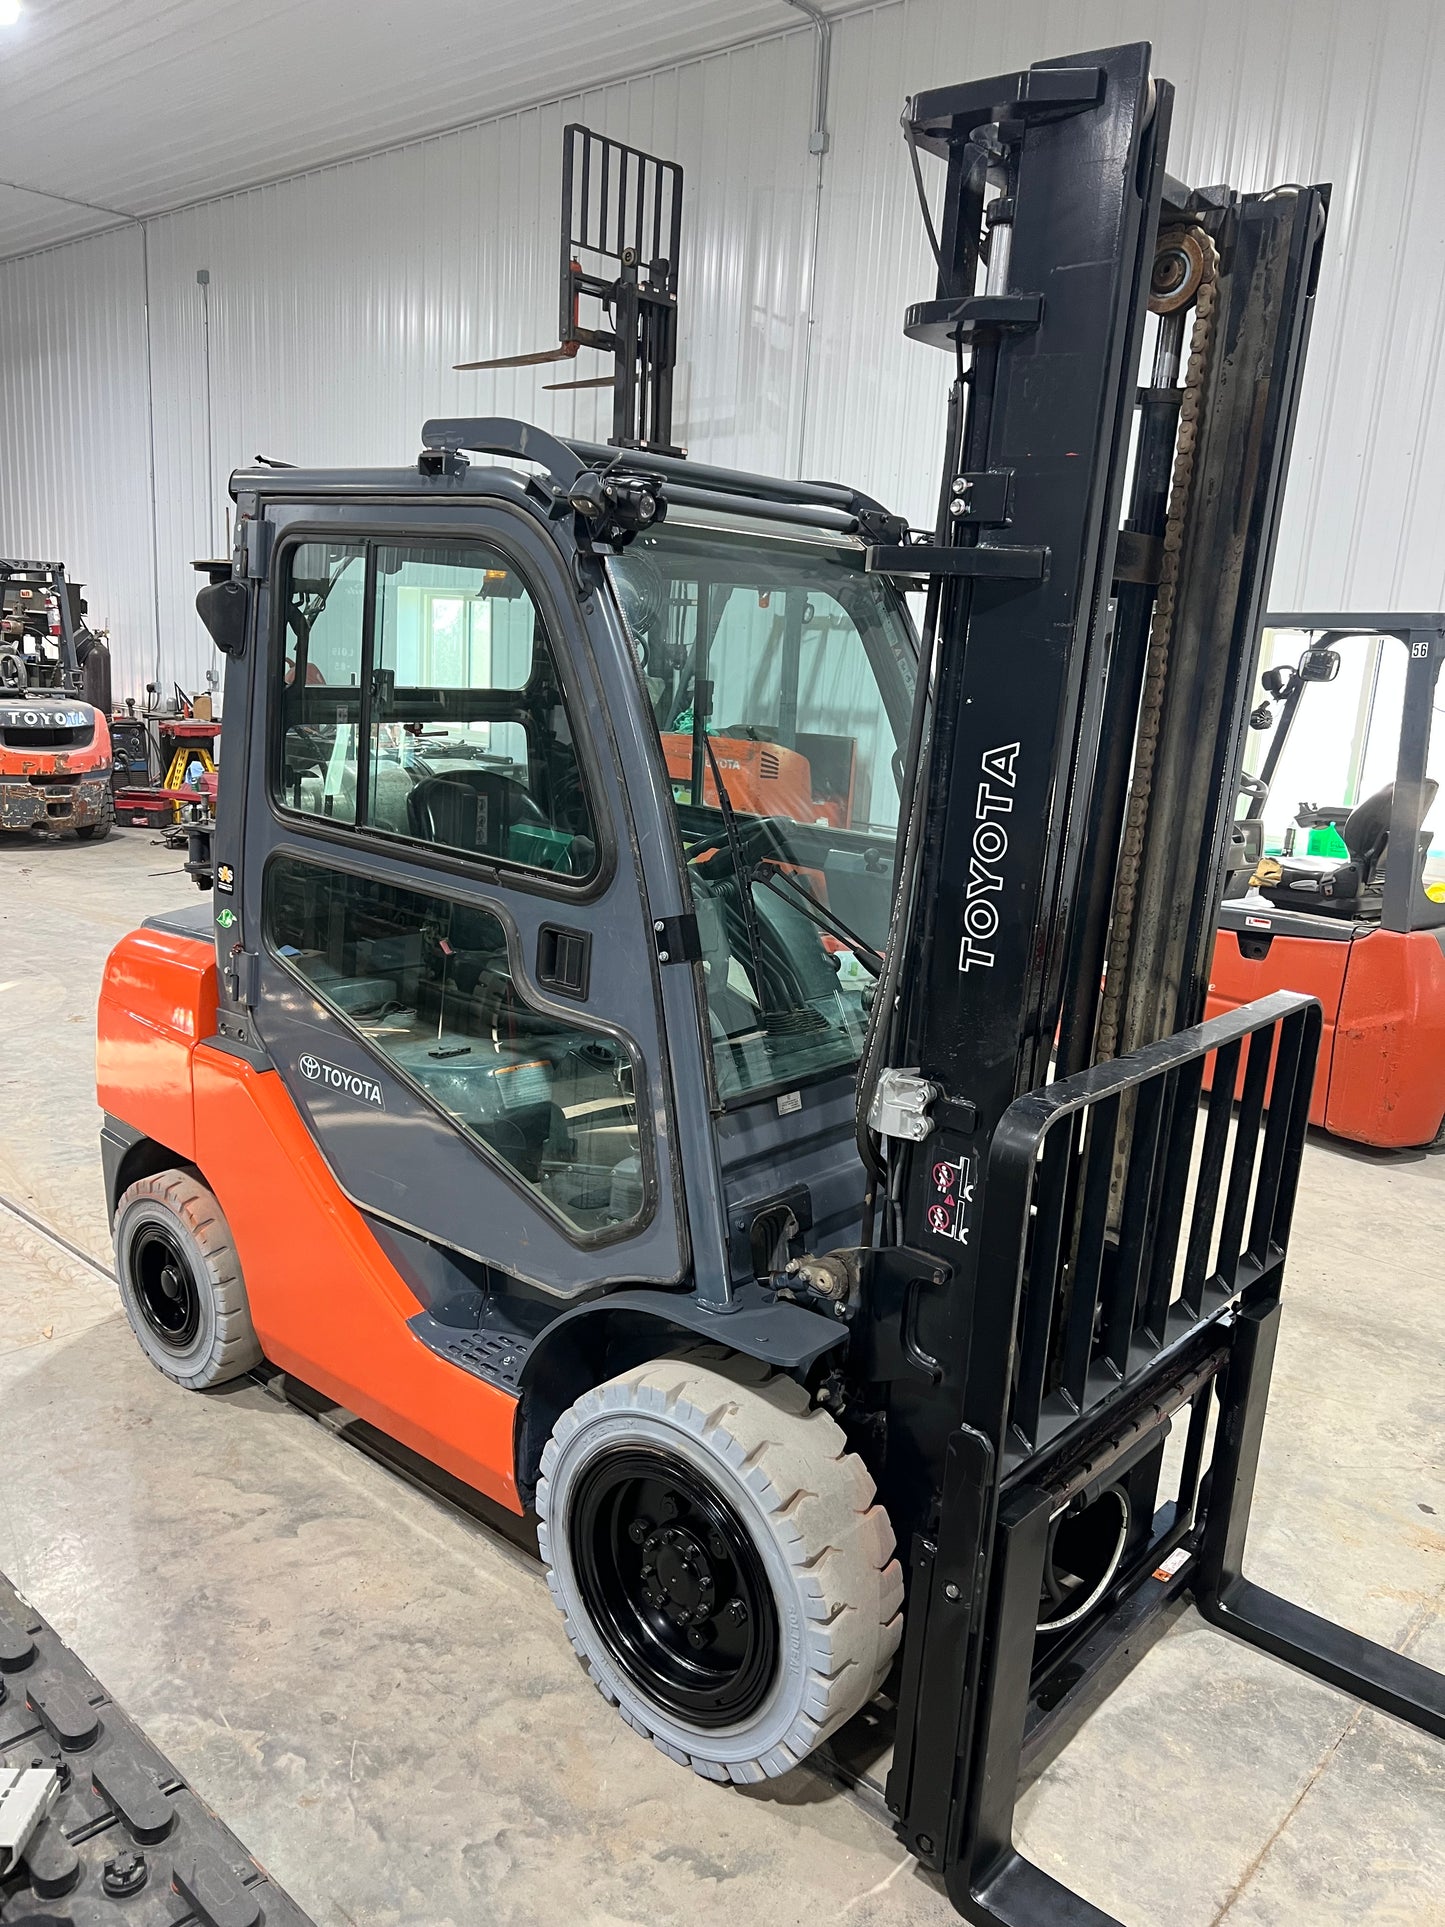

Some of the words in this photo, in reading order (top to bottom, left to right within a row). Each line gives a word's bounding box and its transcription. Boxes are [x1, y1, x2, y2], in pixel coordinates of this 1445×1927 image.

[1413, 643, 1427, 657] 56
[7, 711, 88, 725] TOYOTA
[959, 741, 1021, 972] TOYOTA
[322, 1064, 382, 1105] TOYOTA
